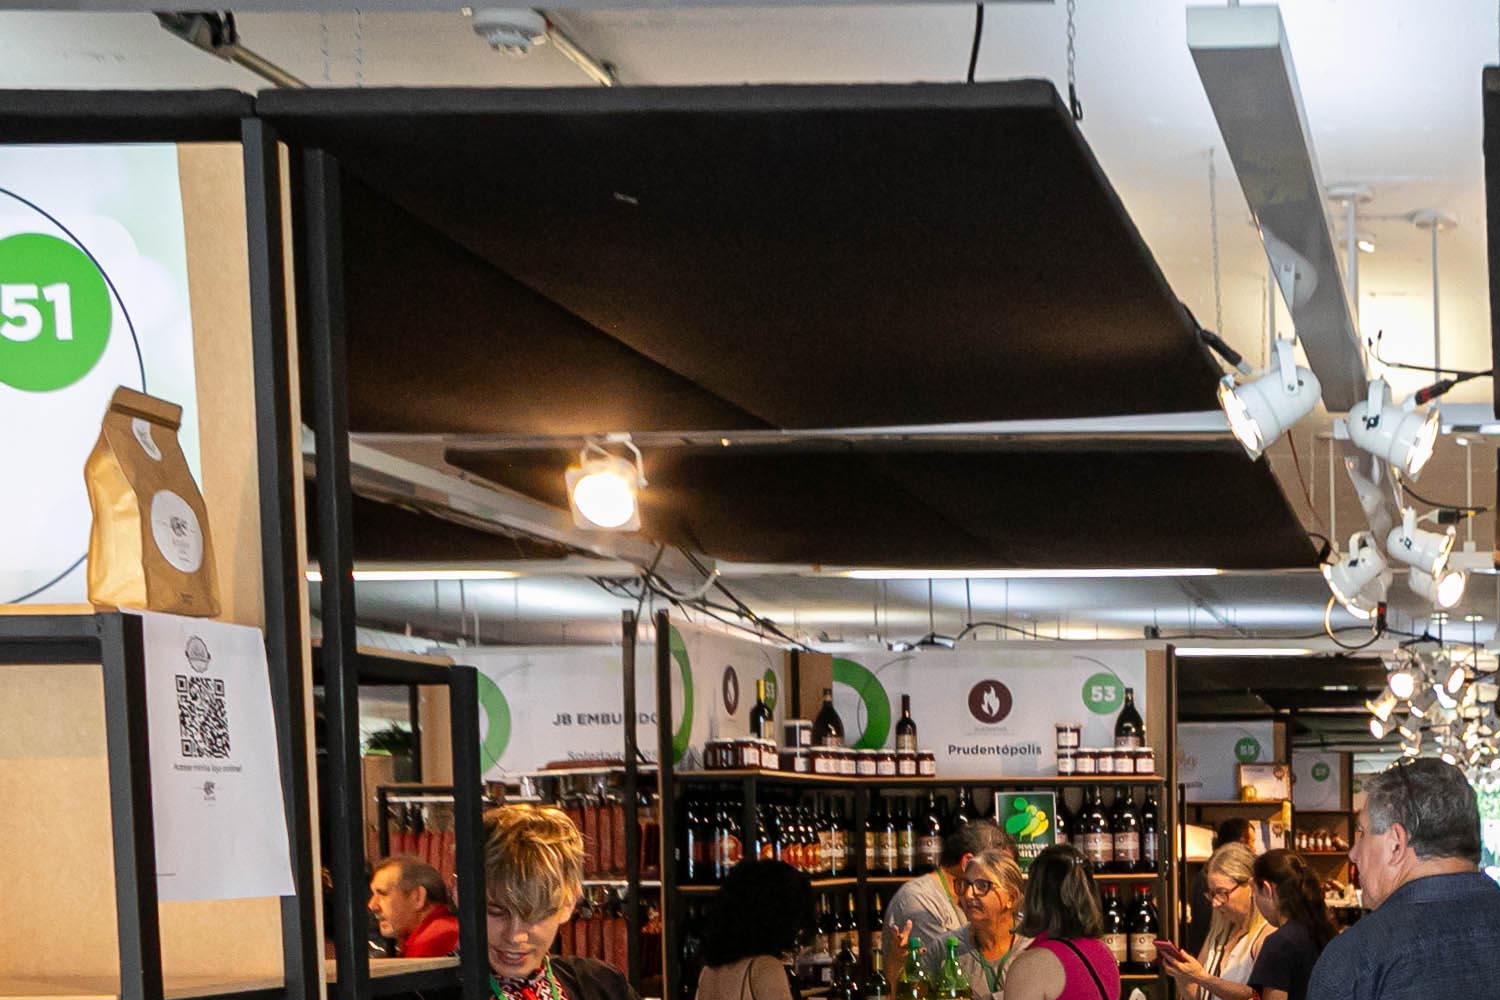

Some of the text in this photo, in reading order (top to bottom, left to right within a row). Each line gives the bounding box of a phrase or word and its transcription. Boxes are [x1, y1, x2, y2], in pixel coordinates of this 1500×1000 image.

[0, 283, 73, 342] 51
[1091, 685, 1116, 702] 53
[553, 713, 571, 726] JB
[948, 743, 1042, 758] Prudentópolis
